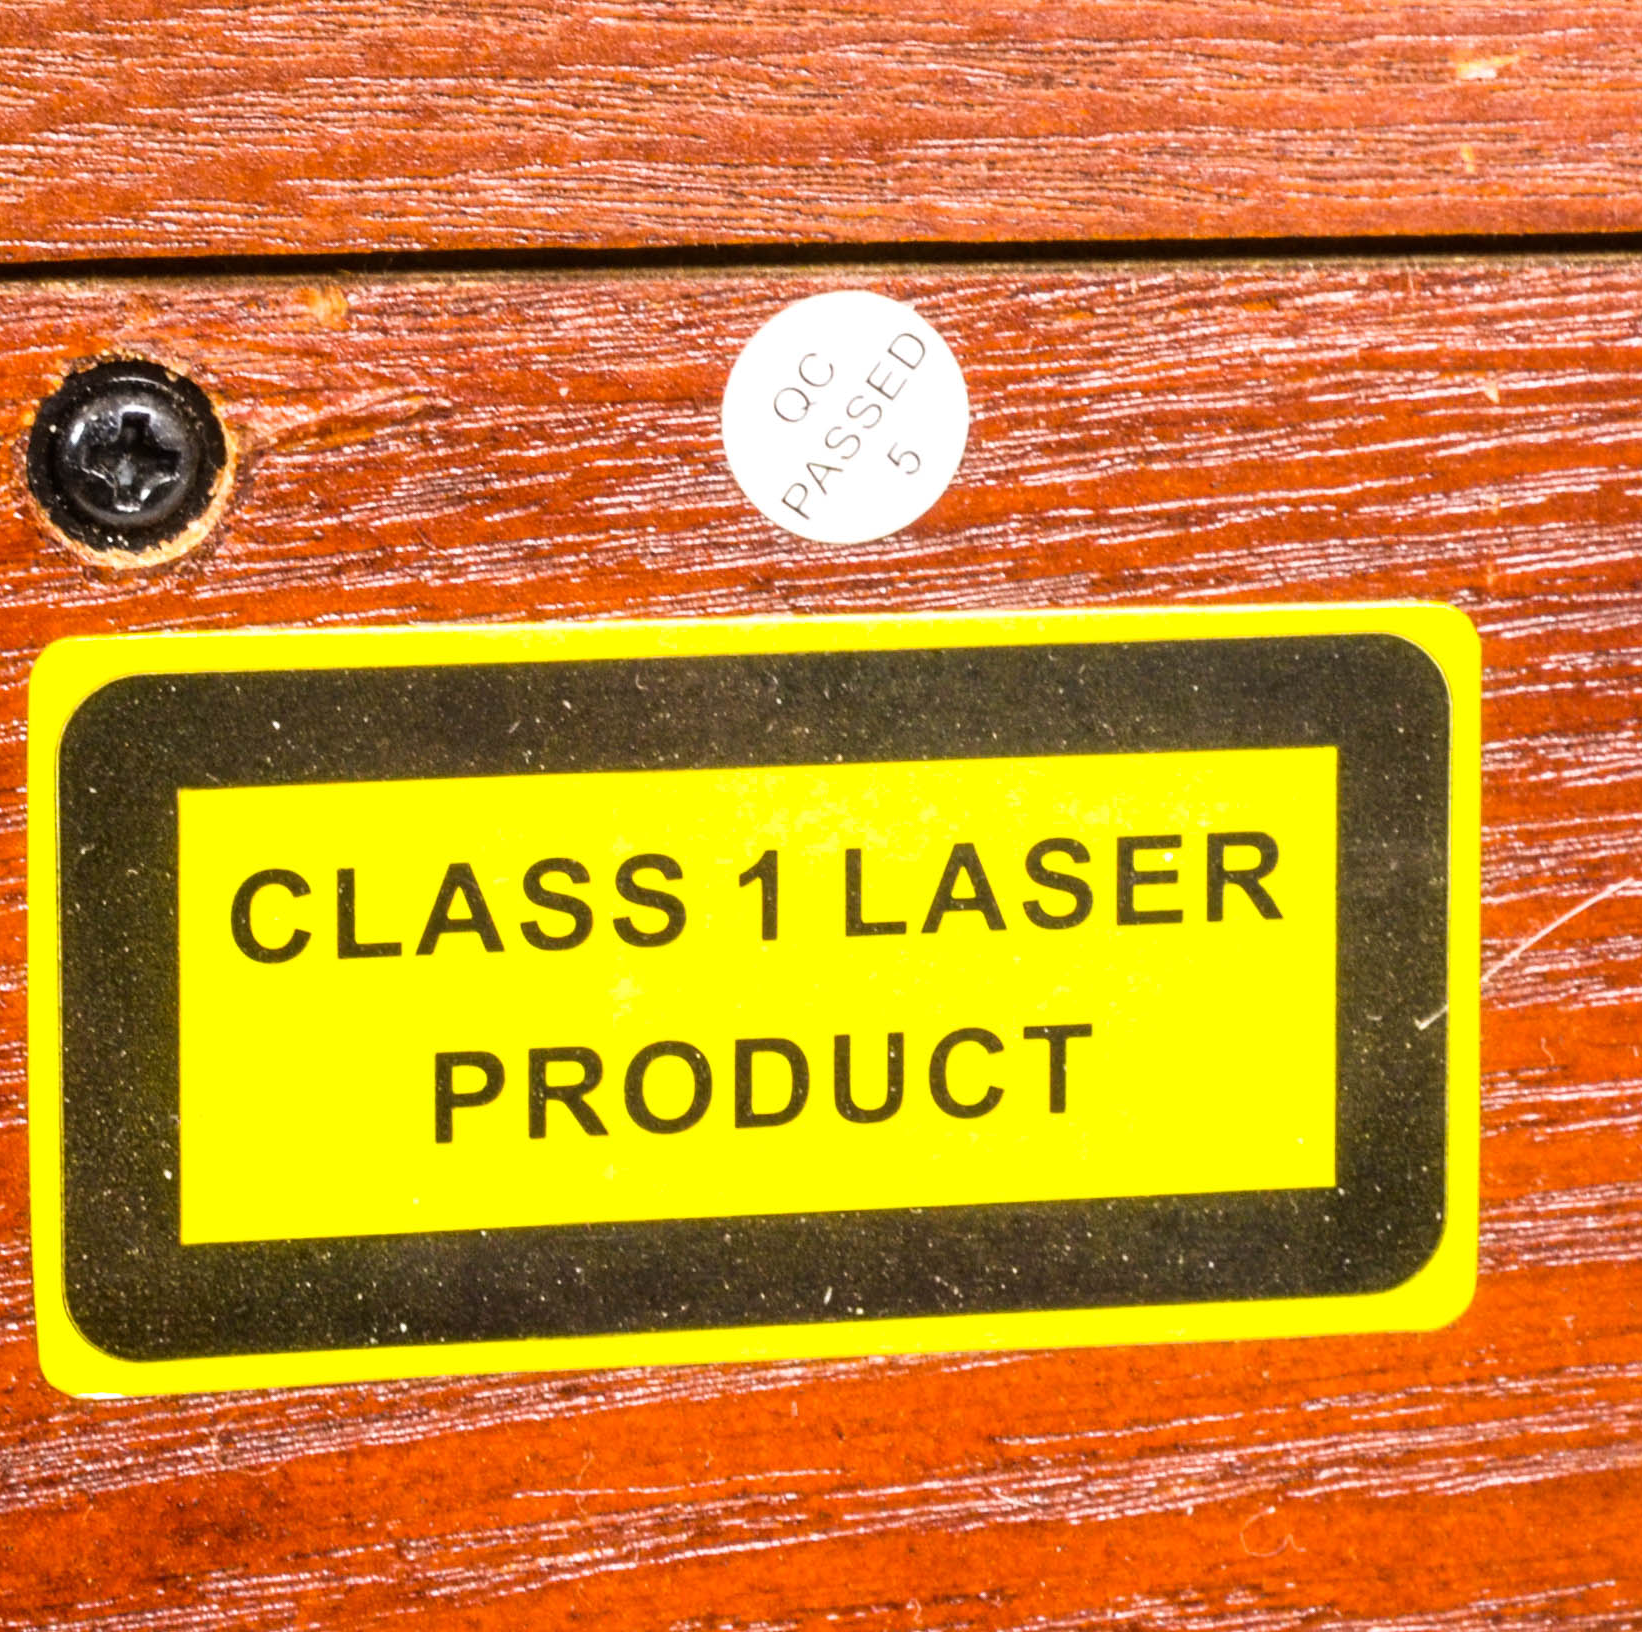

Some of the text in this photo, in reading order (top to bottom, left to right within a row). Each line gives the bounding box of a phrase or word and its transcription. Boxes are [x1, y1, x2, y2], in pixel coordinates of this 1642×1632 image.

[772, 351, 836, 425] QC
[780, 331, 927, 522] PASSED
[885, 440, 923, 477] 5
[229, 831, 1284, 965] CLASS 1 LASER
[434, 1022, 1093, 1144] PRODUCT
